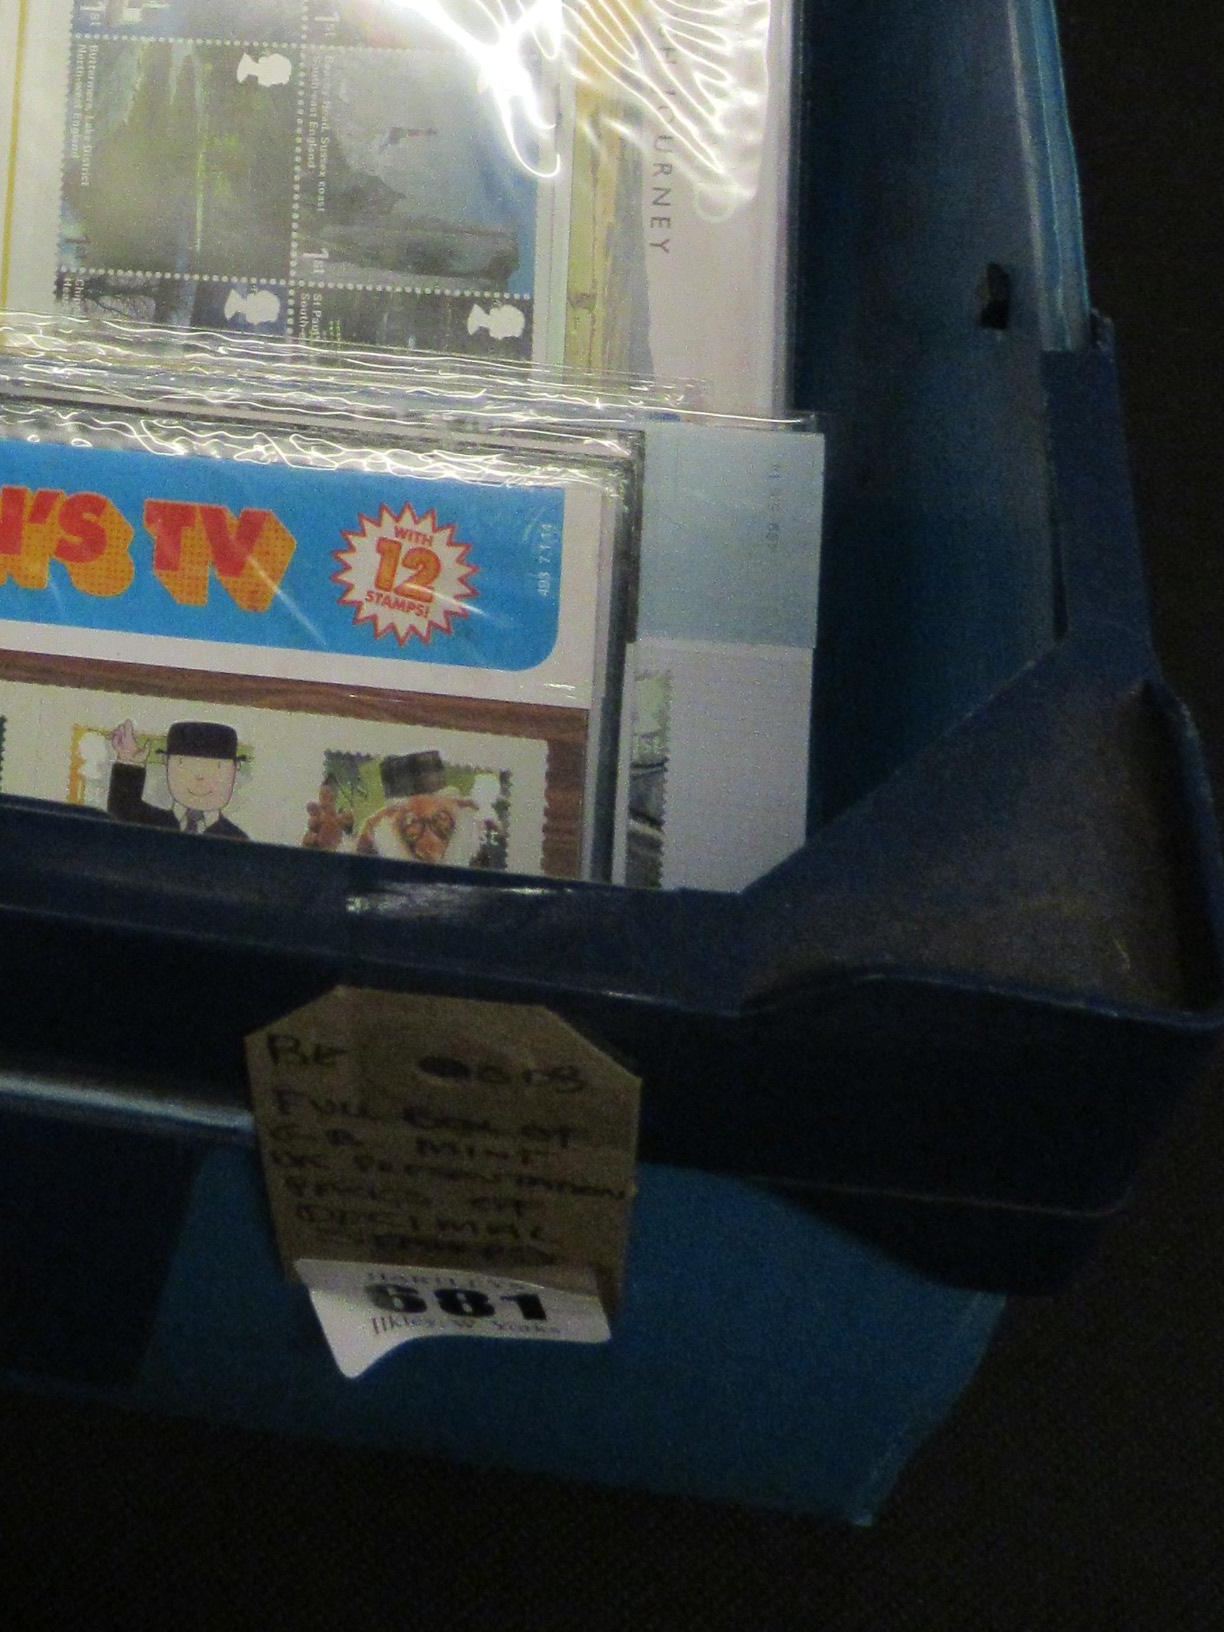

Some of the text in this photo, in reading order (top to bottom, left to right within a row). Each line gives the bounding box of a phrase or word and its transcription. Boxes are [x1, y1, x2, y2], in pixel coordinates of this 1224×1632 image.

[305, 120, 319, 169] England
[317, 136, 331, 178] Sussex
[316, 180, 328, 213] coast
[301, 250, 330, 274] 1st
[145, 499, 296, 612] TV
[393, 525, 434, 548] WITH
[374, 536, 442, 604] 12
[363, 1282, 548, 1322] 681
